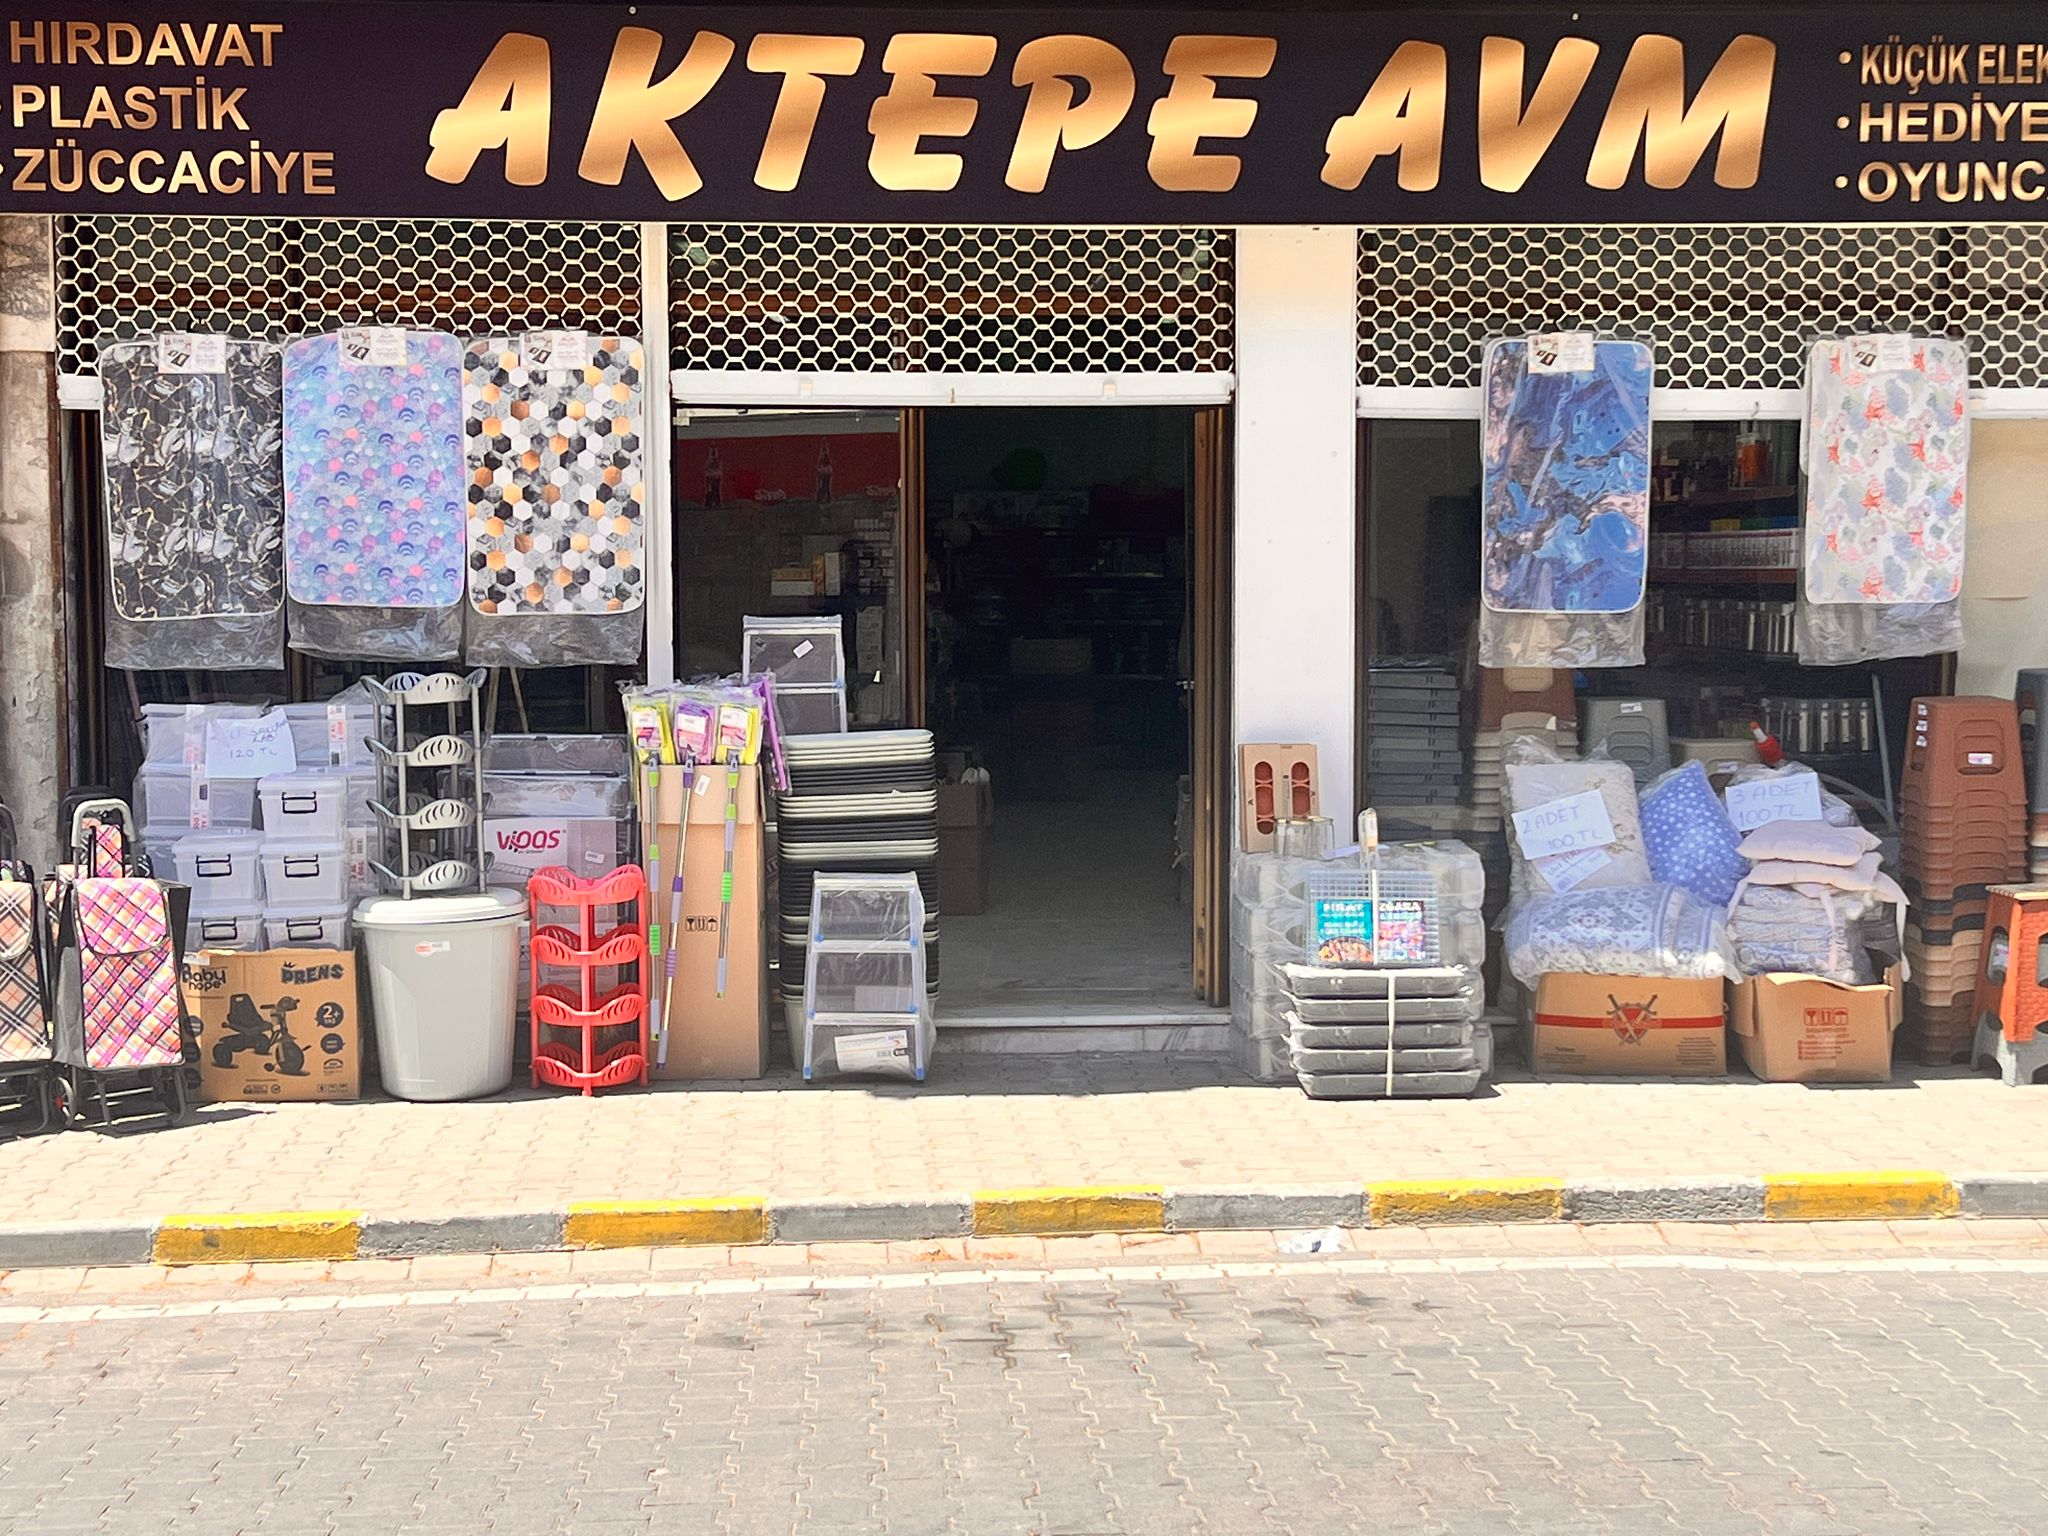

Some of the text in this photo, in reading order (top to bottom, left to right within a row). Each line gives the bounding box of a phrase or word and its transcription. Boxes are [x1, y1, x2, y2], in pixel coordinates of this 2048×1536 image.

[9, 20, 284, 68] HIRDAVAT
[1861, 35, 2048, 95] KÜÇÜK ELEK
[12, 76, 250, 131] PLASTİK
[425, 26, 1777, 201] AKTEPE AVM
[1859, 92, 2048, 142] HEDİYE
[11, 139, 336, 195] ZÜCCACİYE
[230, 749, 255, 759] 120
[1752, 781, 1814, 801] ADET
[1534, 805, 1580, 829] ADET
[1739, 804, 1804, 827] 100 TL
[1547, 830, 1604, 850] 100 TL
[182, 963, 226, 985] Baby
[281, 964, 344, 985] PRENS
[188, 980, 222, 992] hope
[322, 1005, 340, 1018] 2+
